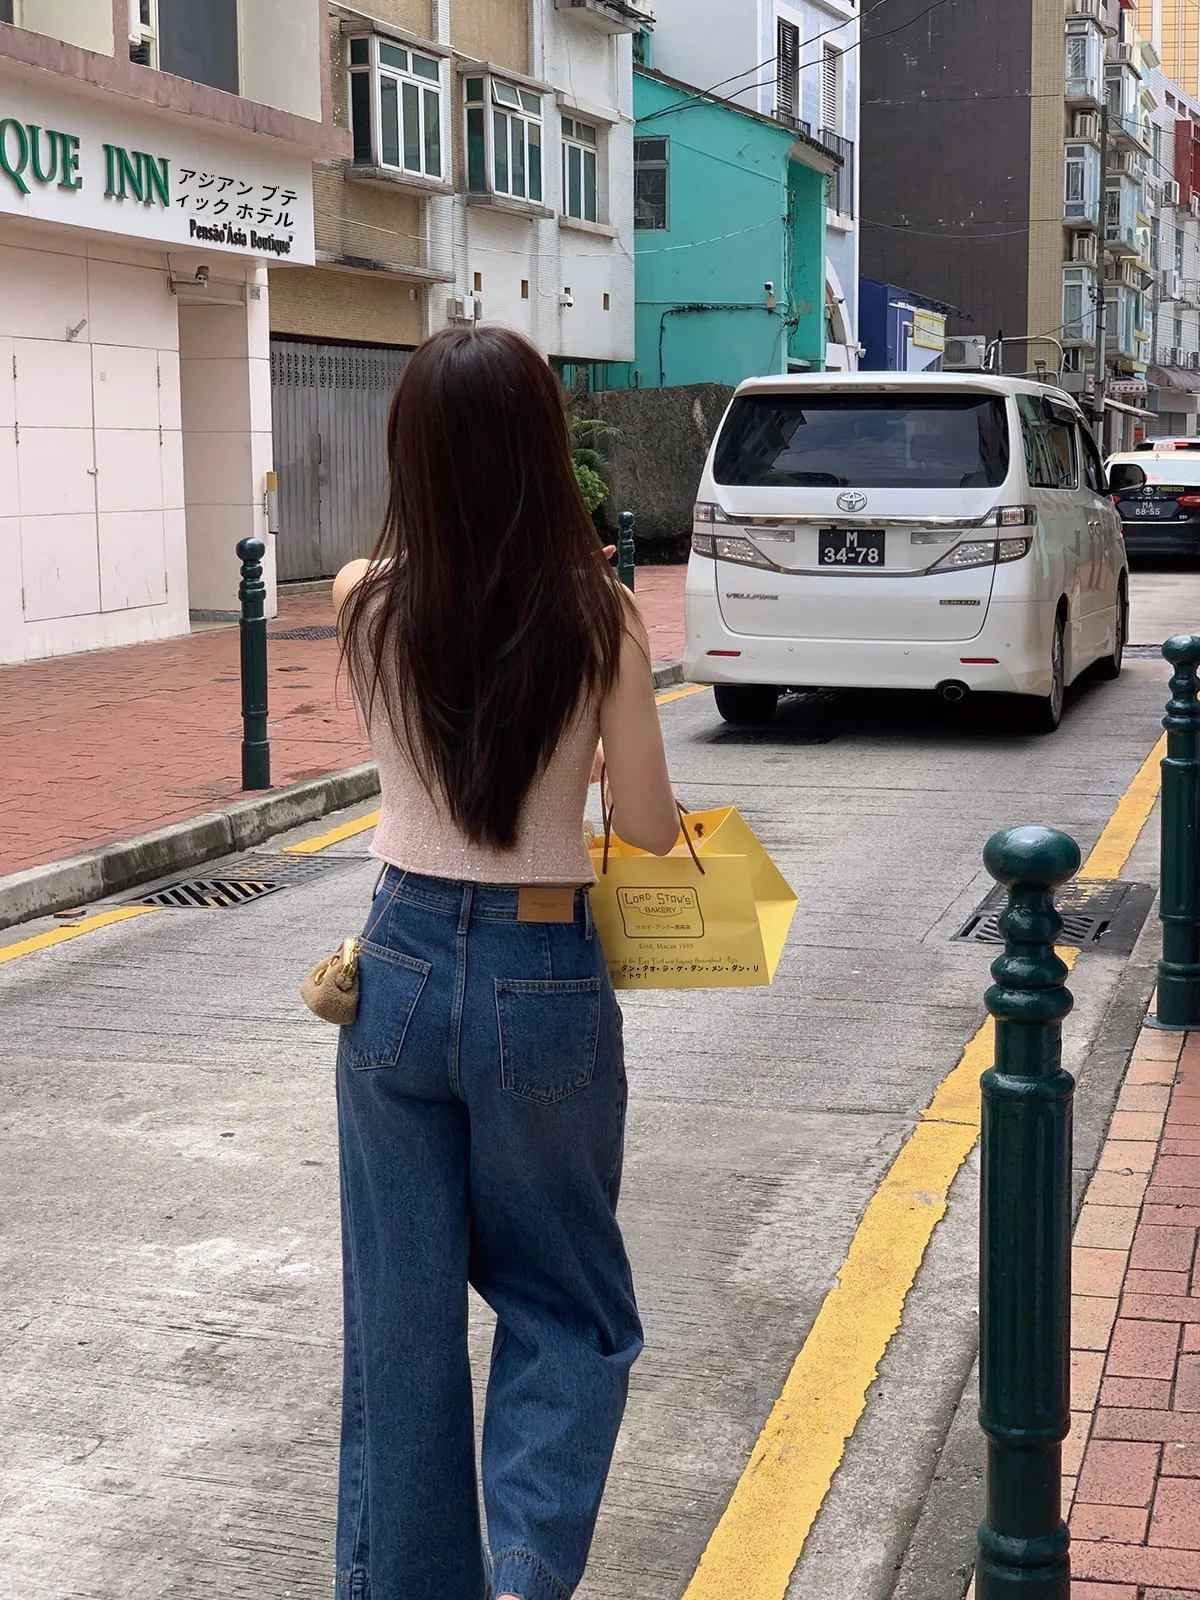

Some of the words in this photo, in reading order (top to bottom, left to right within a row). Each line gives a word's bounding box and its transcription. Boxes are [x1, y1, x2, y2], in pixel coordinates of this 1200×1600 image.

[0, 118, 83, 194] QUE
[103, 143, 171, 208] INN
[236, 203, 294, 228] ホテル
[846, 531, 858, 548] M
[823, 547, 879, 563] 34-78
[624, 892, 652, 905] LORD
[644, 906, 677, 914] BAKERY
